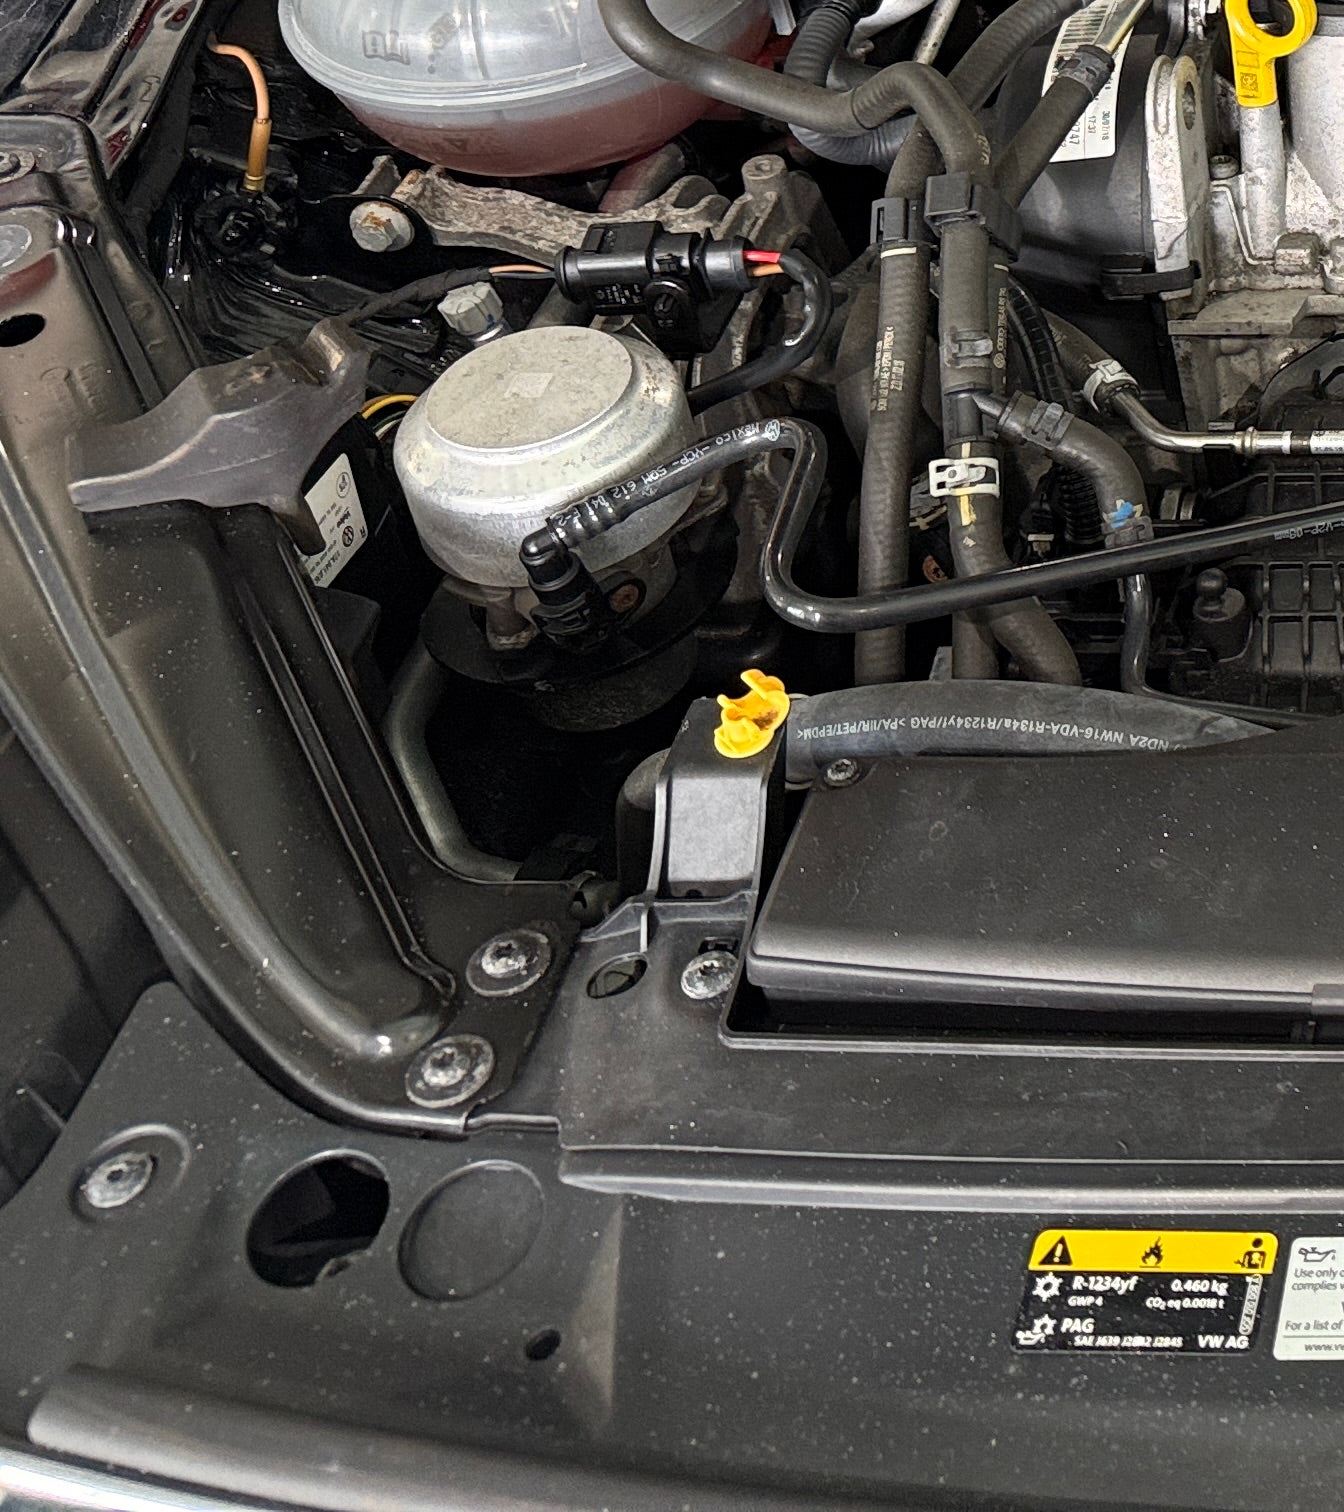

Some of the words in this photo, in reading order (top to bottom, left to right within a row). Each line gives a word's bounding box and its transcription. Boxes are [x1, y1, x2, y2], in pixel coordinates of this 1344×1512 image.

[1128, 732, 1169, 752] ND2A
[1294, 1268, 1315, 1278] Use
[1315, 1268, 1339, 1280] only
[1072, 1275, 1139, 1295] R-1234yf
[1170, 1279, 1210, 1293] 0.460
[1210, 1278, 1229, 1297] kg
[1291, 1281, 1338, 1293] complies
[1067, 1296, 1095, 1307] GWP
[1095, 1296, 1104, 1307] 4
[1060, 1318, 1096, 1334] PAG
[1284, 1320, 1303, 1331] For
[1304, 1321, 1311, 1330] a
[1313, 1319, 1329, 1330] list
[1330, 1318, 1344, 1330] of
[1197, 1335, 1225, 1349] VW
[1225, 1335, 1250, 1349] AG
